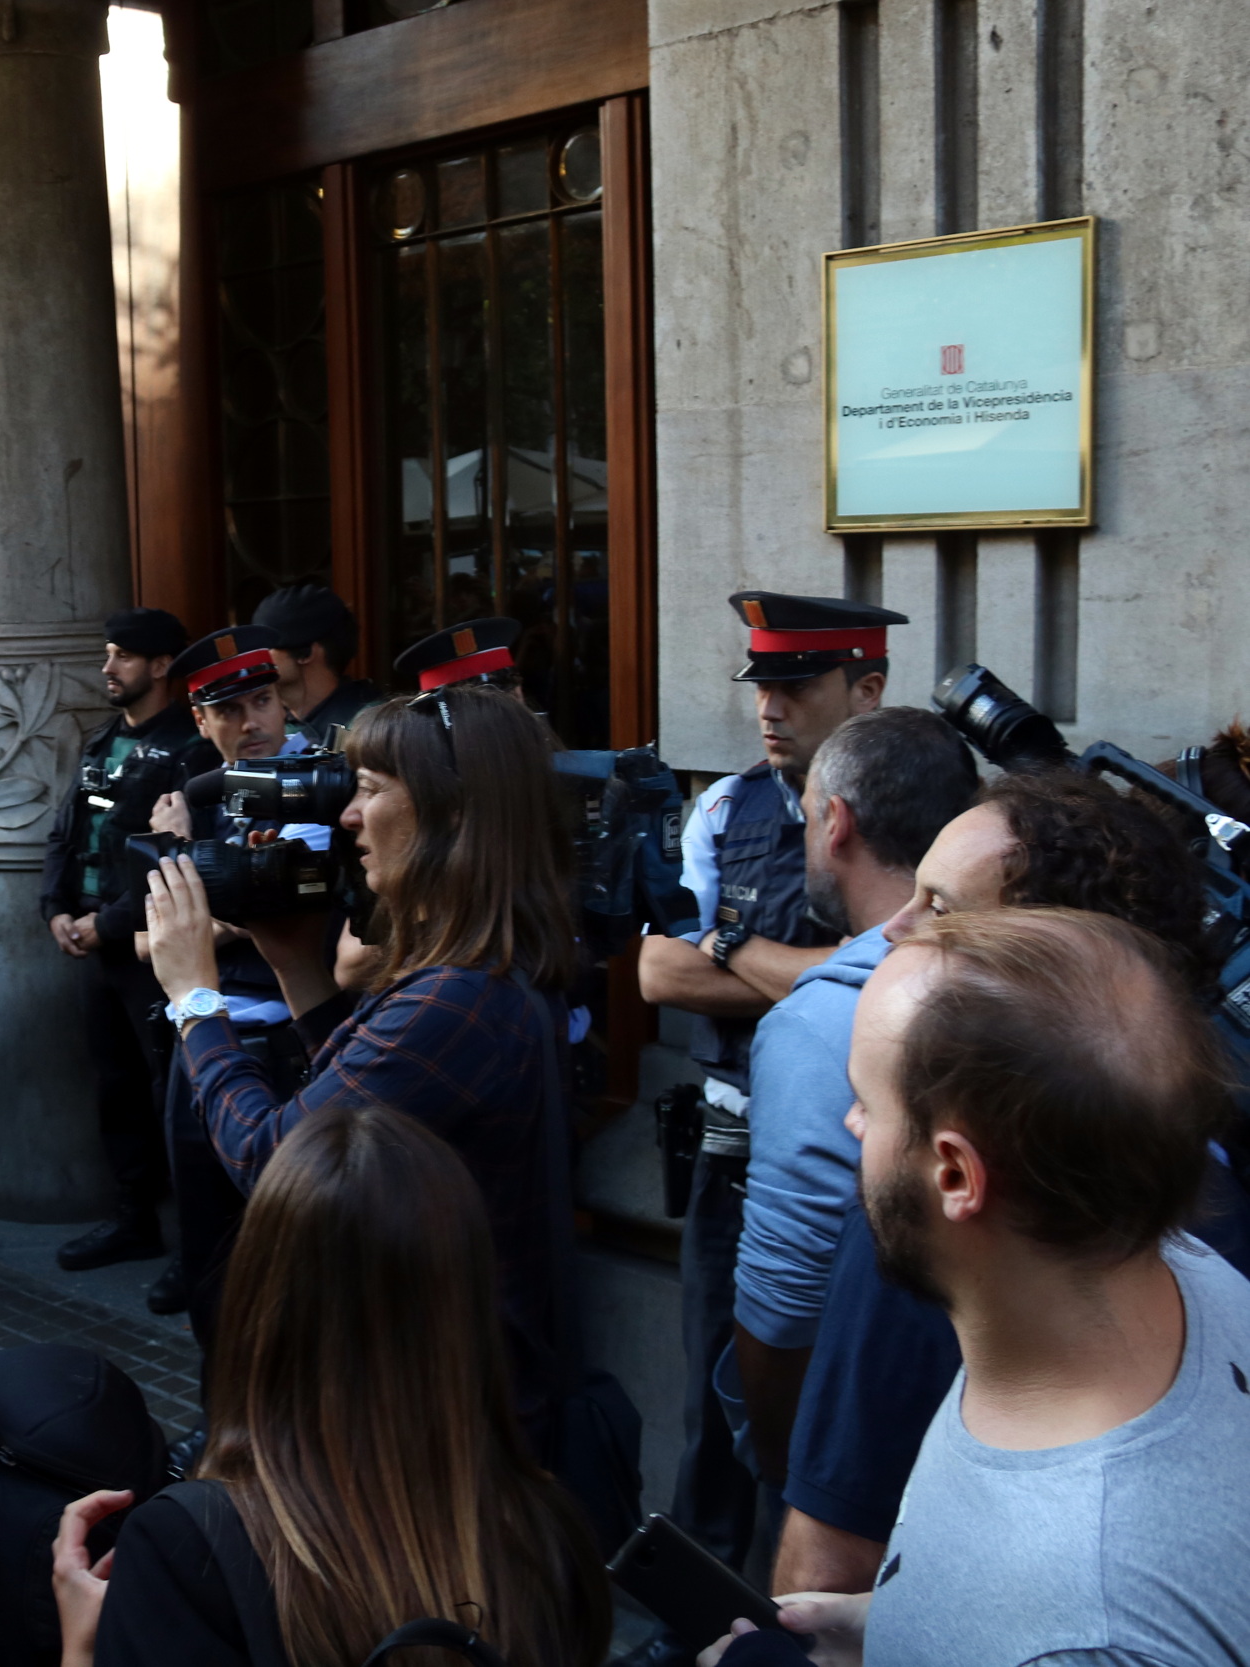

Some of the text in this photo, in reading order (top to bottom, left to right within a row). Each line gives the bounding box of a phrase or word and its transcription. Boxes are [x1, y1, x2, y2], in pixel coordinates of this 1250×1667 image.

[881, 379, 1028, 399] Generalitat de Catalunya
[842, 389, 1073, 418] Departament de la Vicepresidència
[878, 408, 1029, 429] i d'Economia i Hisenda
